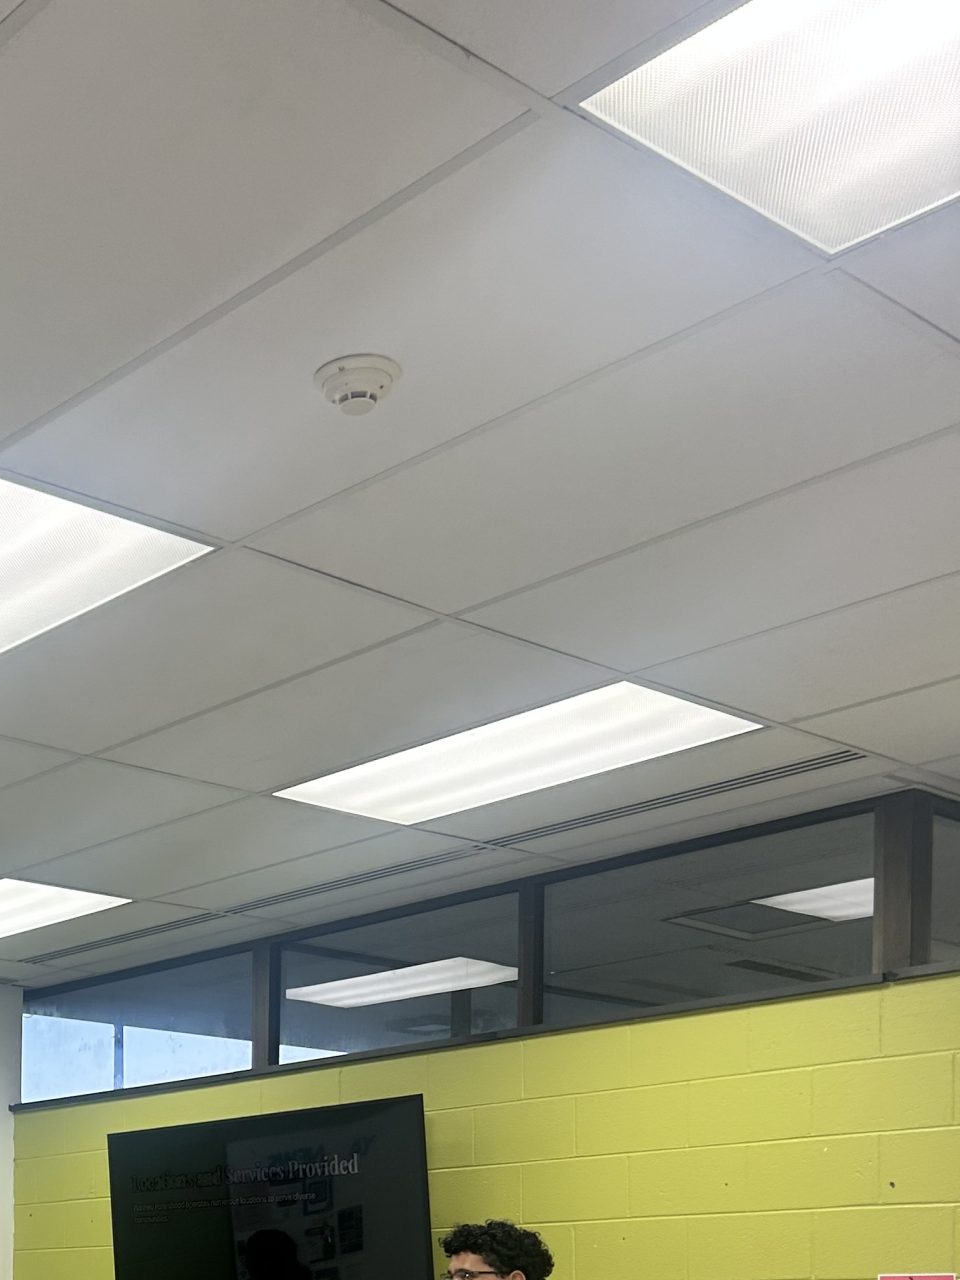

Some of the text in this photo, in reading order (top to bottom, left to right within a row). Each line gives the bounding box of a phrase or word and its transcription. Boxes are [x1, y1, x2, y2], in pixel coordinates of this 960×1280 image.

[225, 1161, 284, 1185] Services
[287, 1152, 358, 1181] Provided
[292, 1191, 315, 1201] diverse
